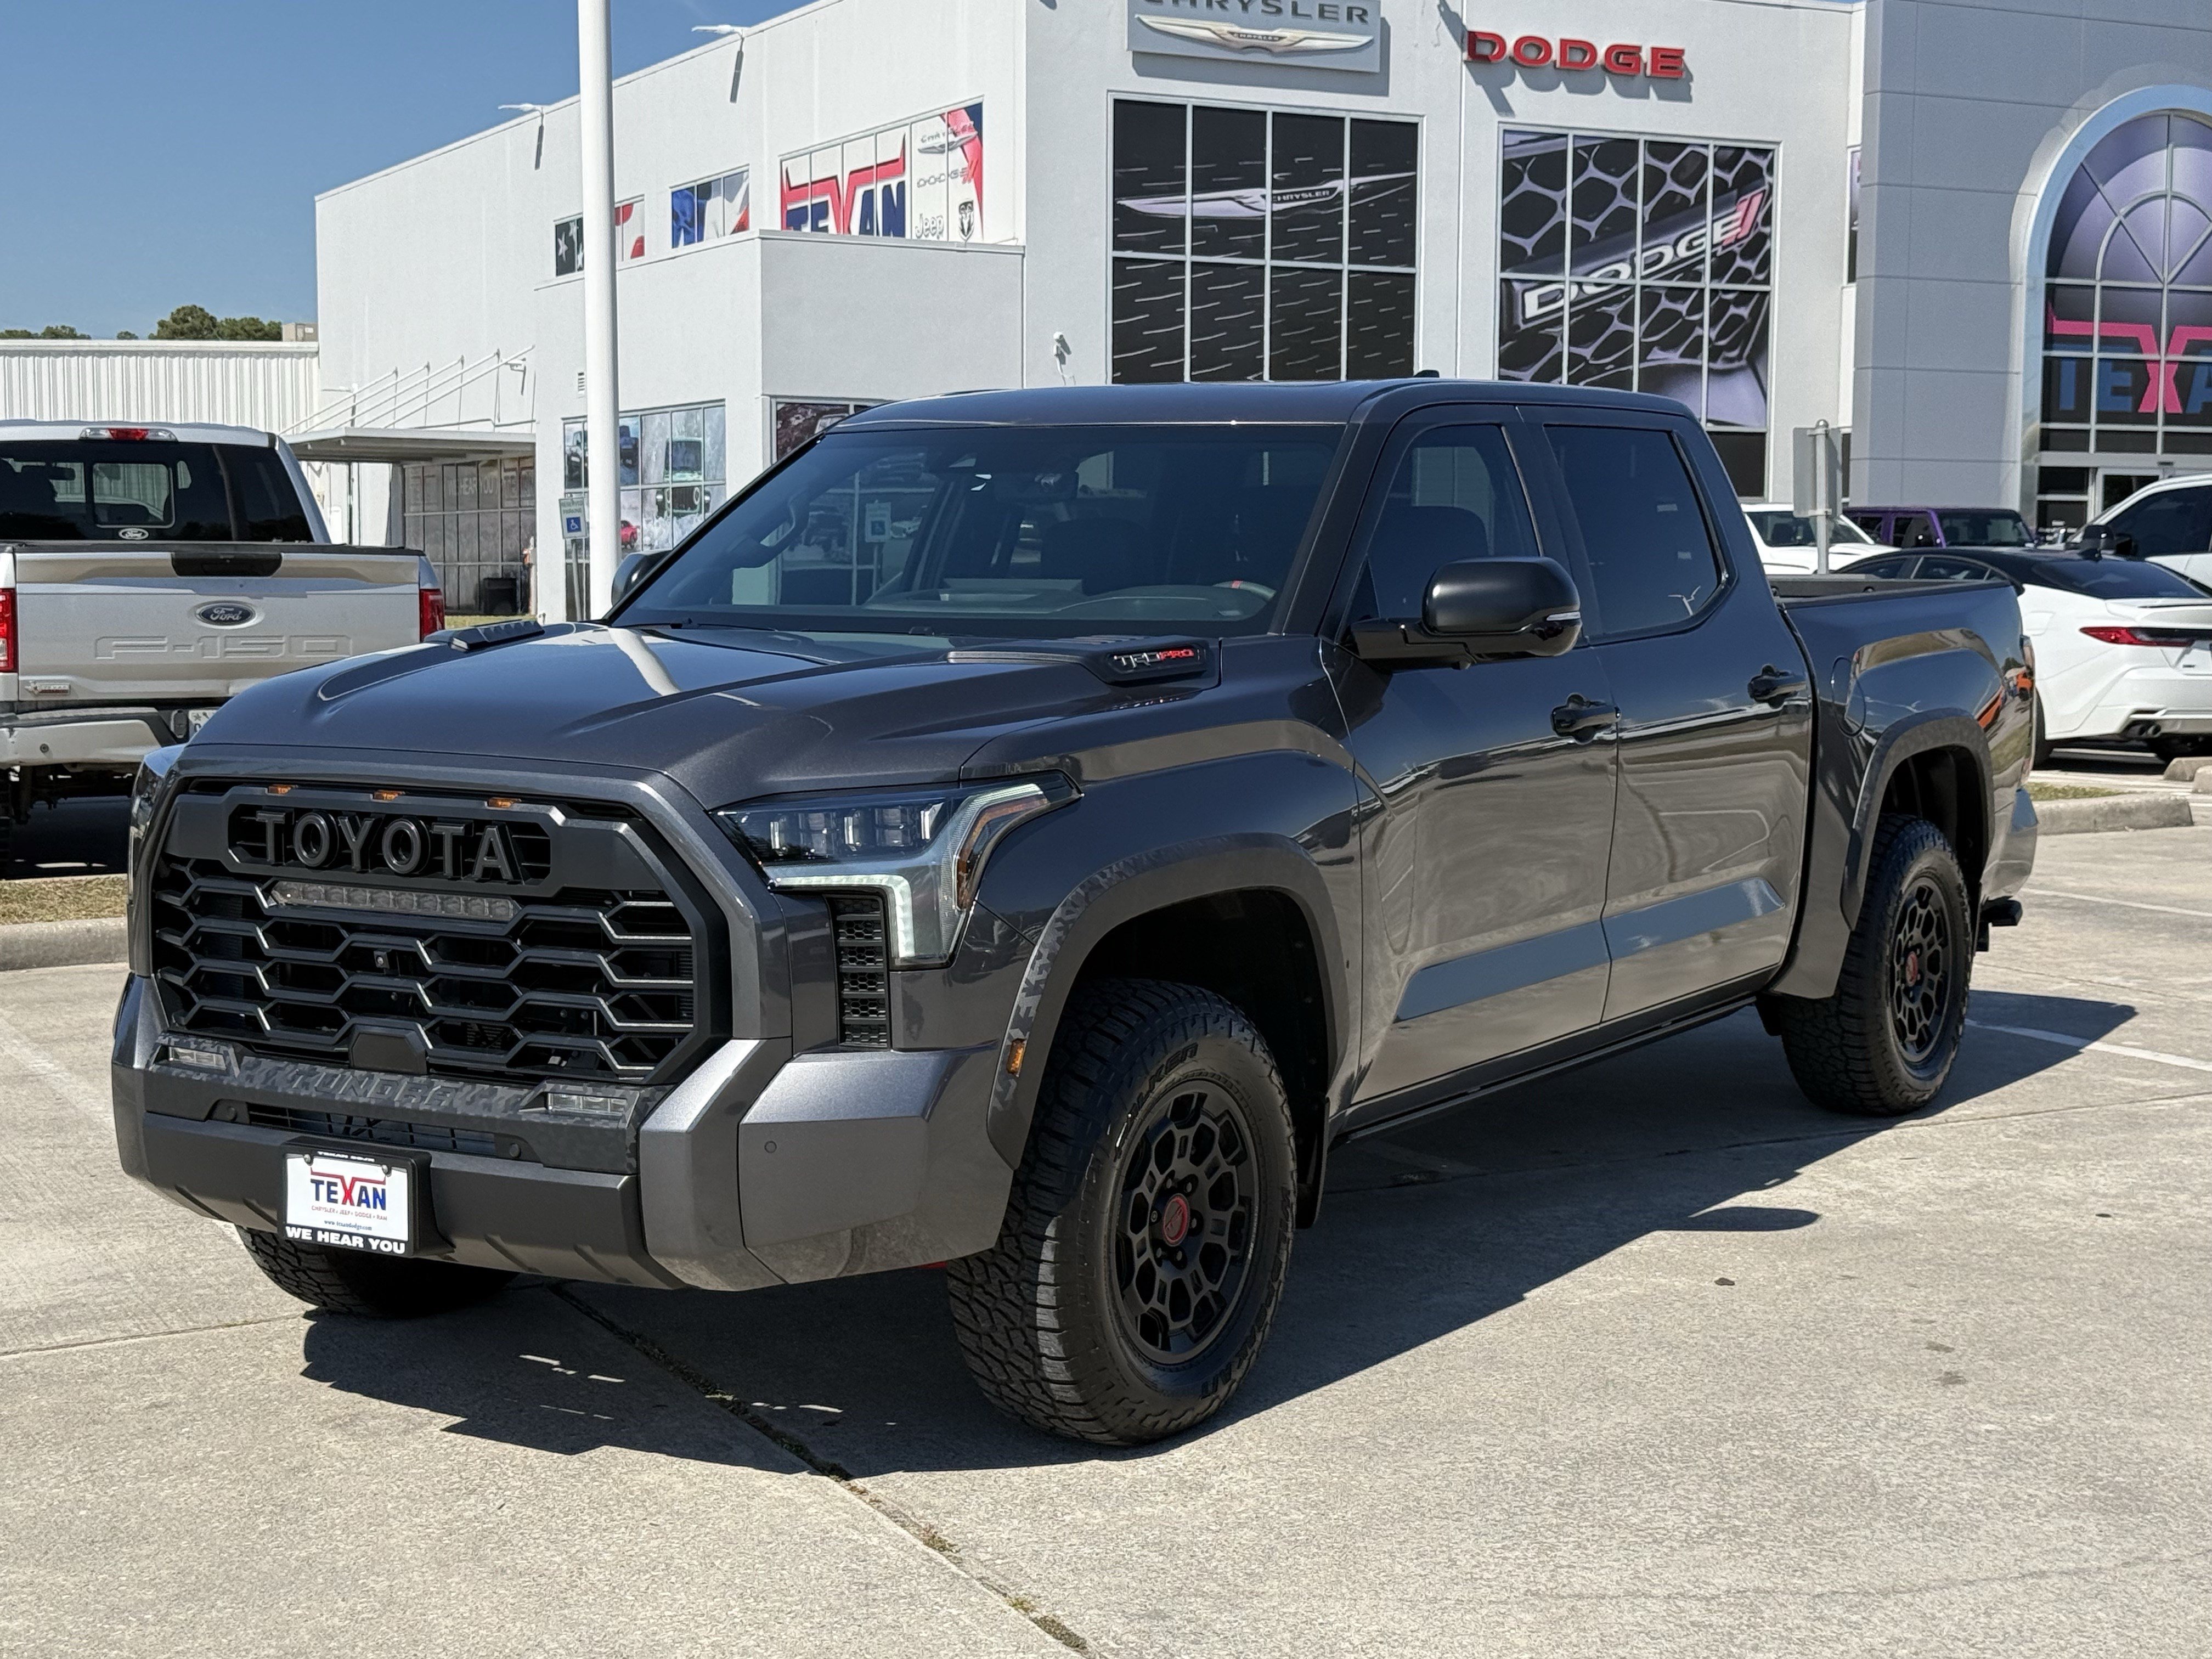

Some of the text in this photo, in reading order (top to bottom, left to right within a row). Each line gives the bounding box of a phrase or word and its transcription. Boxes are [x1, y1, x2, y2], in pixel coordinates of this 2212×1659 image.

[1142, 0, 1369, 24] RYSLER
[1464, 30, 1685, 78] DODGE
[915, 213, 944, 240] Jeep
[1523, 211, 1742, 320] DODGE
[210, 607, 242, 620] Ford
[95, 635, 352, 658] F-150
[255, 810, 518, 881] TOYOTA
[291, 1069, 458, 1107] TUNDRA
[310, 1167, 386, 1210] TEXAN
[285, 1226, 405, 1254] WE HEAR YOU
